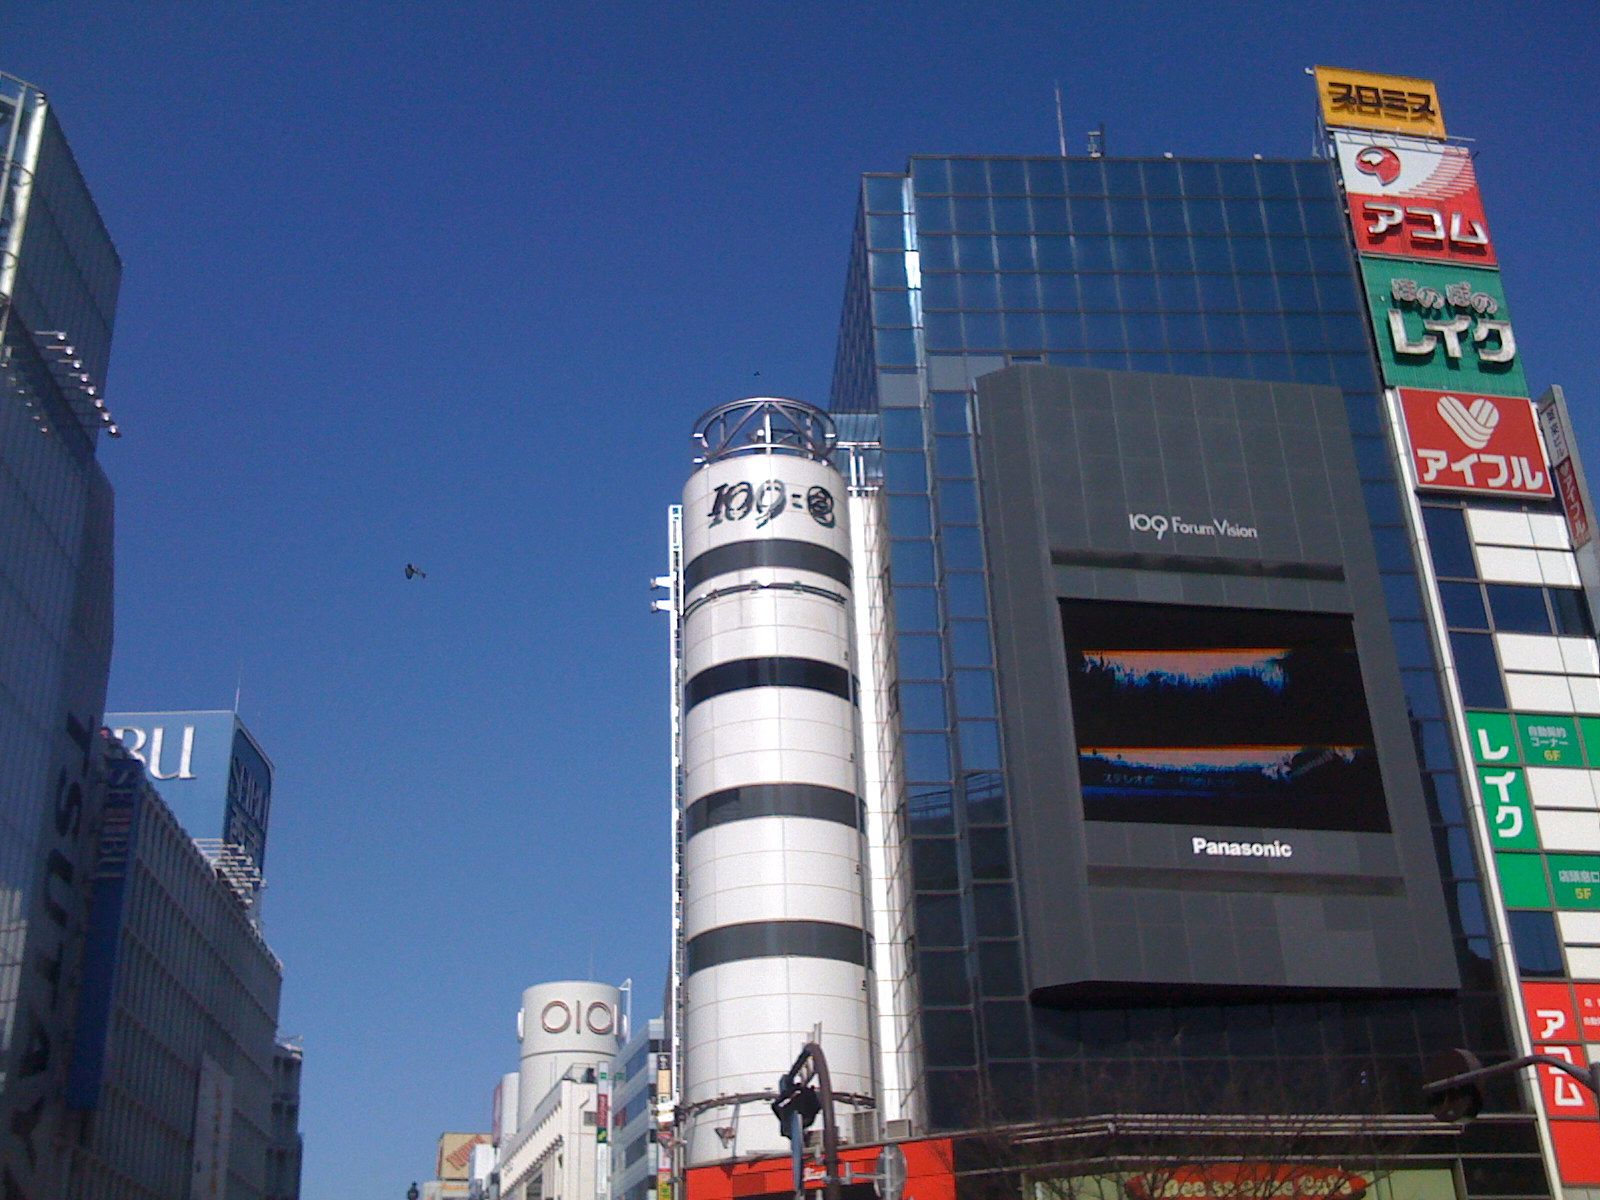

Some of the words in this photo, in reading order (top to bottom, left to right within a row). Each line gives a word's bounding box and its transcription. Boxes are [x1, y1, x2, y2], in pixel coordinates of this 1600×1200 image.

[1328, 82, 1435, 115] プロミス
[1364, 202, 1488, 246] アコム
[1387, 308, 1517, 362] レイク
[1416, 448, 1543, 490] アイフル
[1129, 513, 1168, 540] 109
[1172, 516, 1215, 535] Forum
[1213, 518, 1258, 538] Vision
[1477, 728, 1523, 838] レイク
[1191, 836, 1293, 858] Panasonic
[1536, 1009, 1585, 1107] アコム
